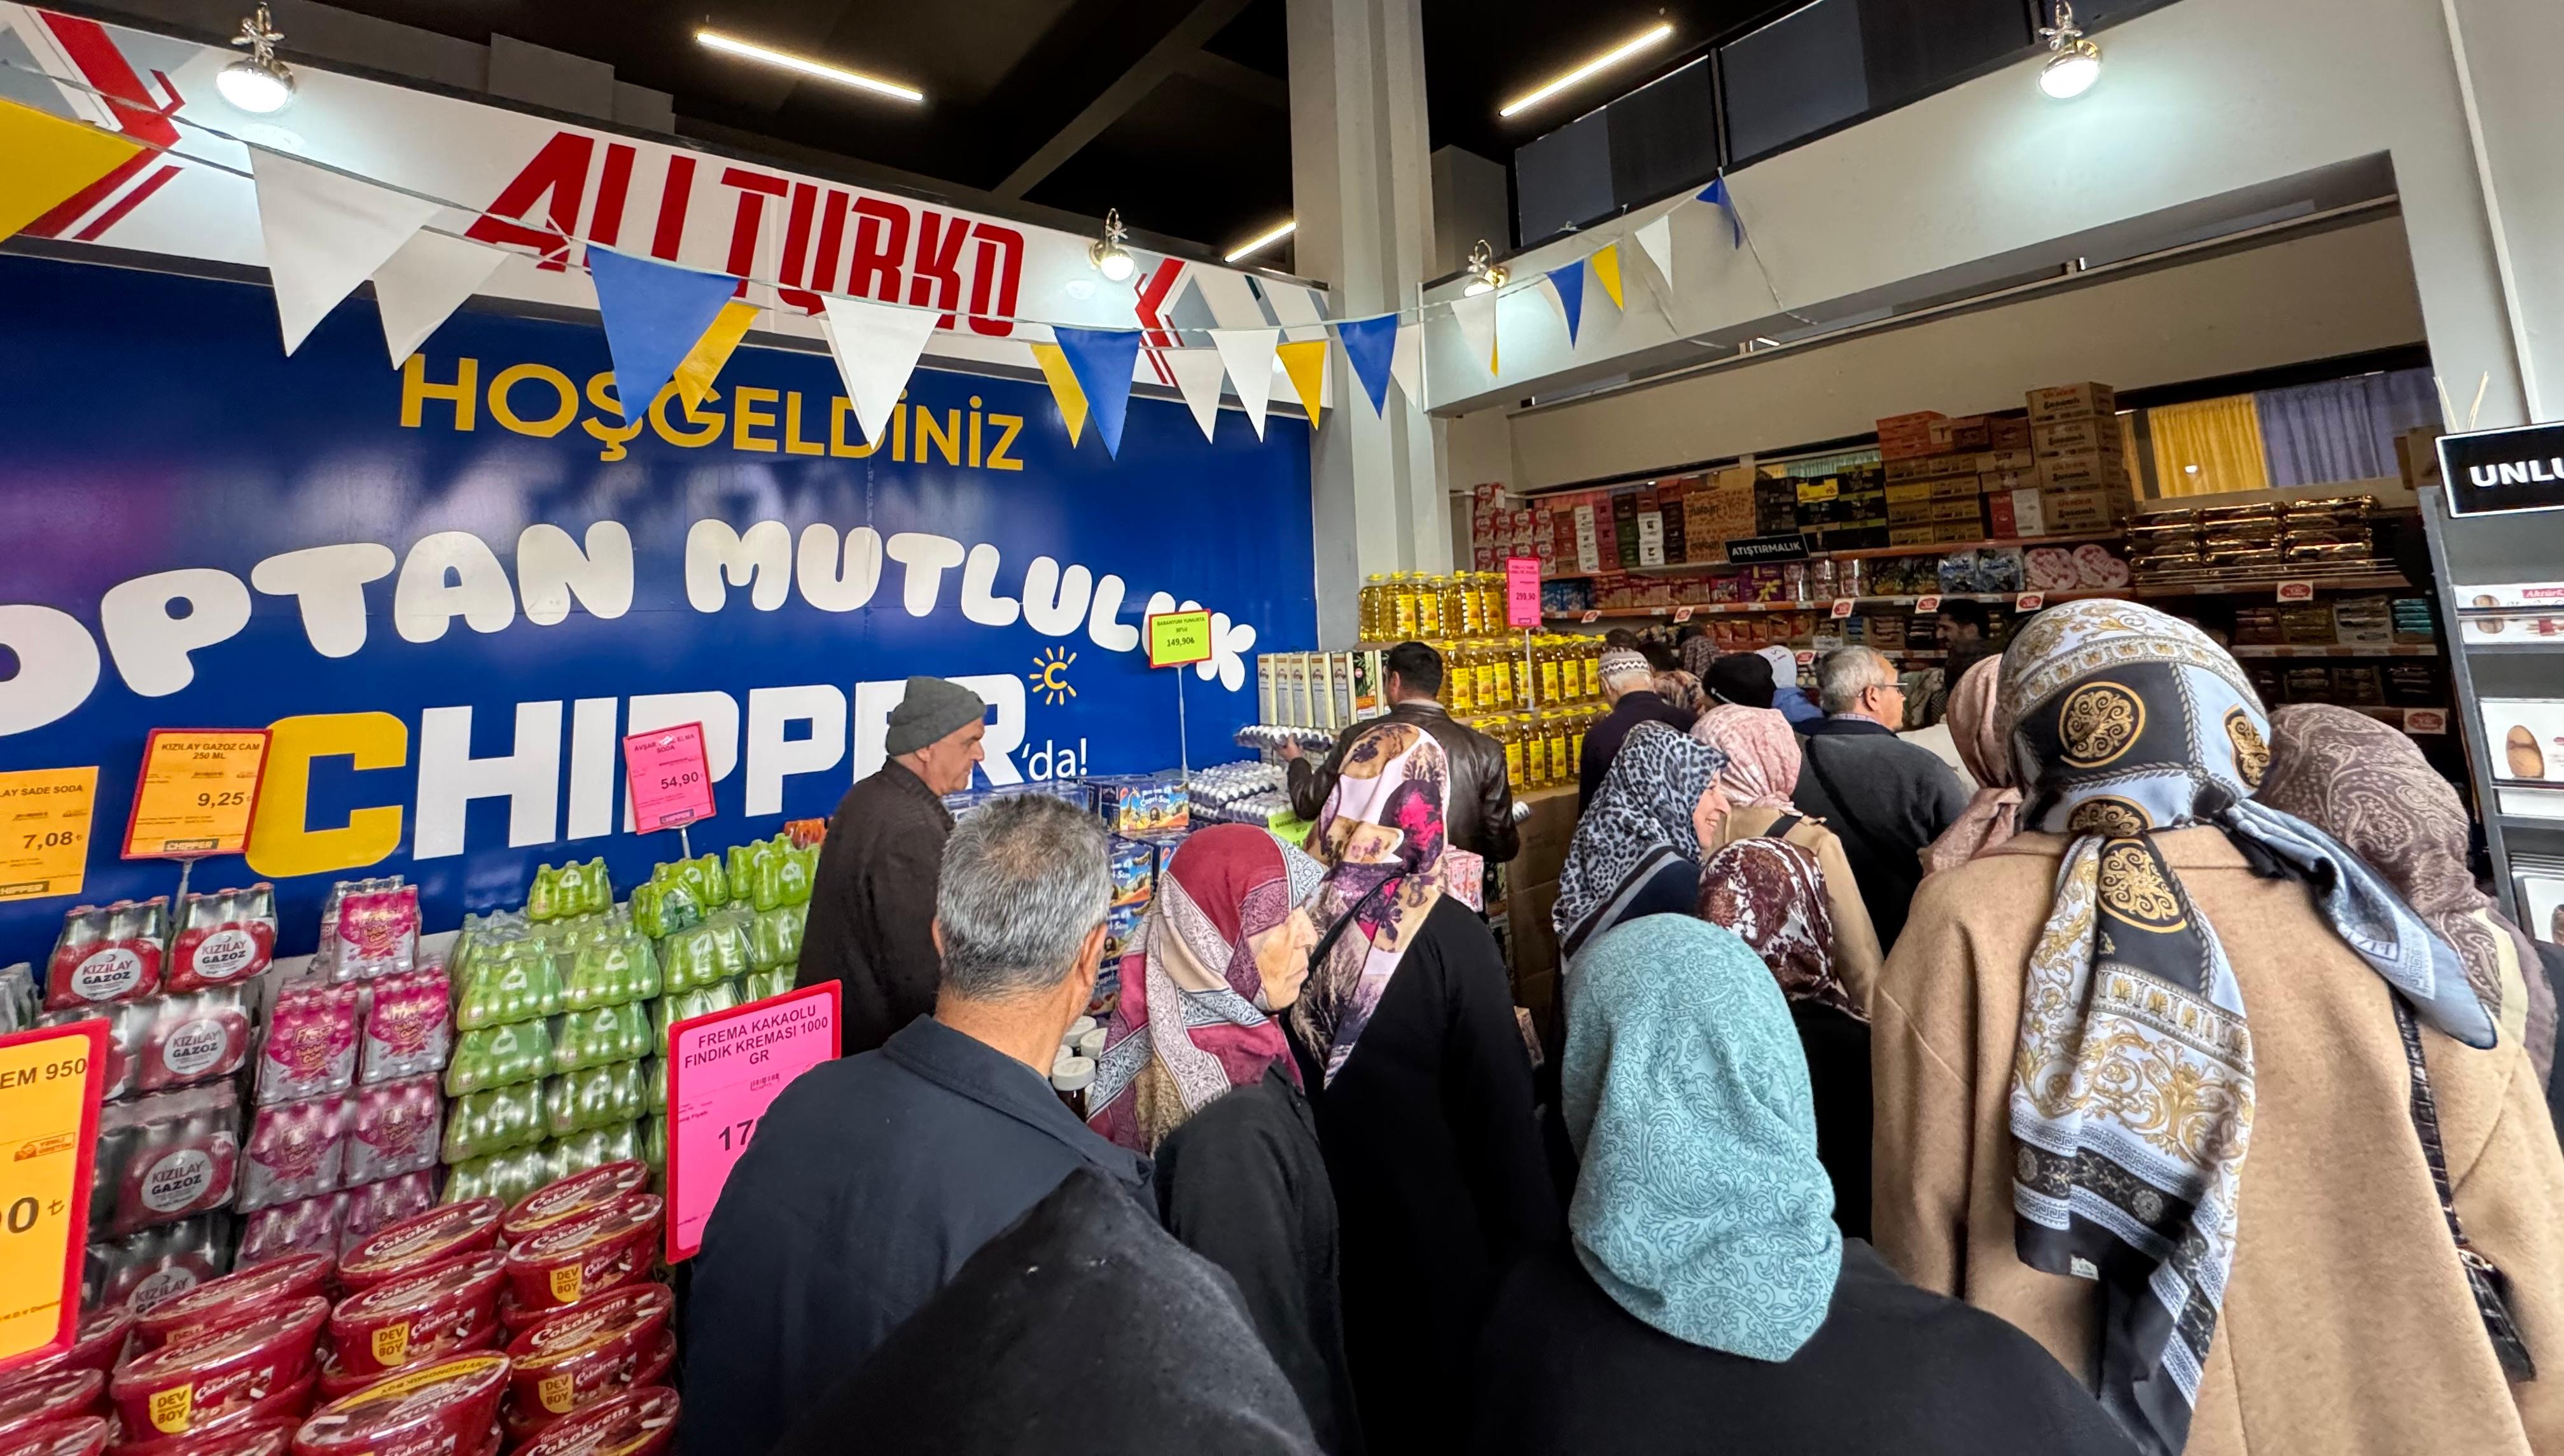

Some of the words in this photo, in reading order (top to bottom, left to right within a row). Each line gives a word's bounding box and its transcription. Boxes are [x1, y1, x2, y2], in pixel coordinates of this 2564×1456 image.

[1732, 541, 1802, 558] ATIŞTIRMALIK
[162, 743, 200, 751] KIZILAY
[203, 743, 237, 751] GAZOZ
[193, 752, 210, 760] 250
[660, 772, 699, 790] 54,90
[20, 786, 50, 796] SADE
[23, 831, 73, 851] 7,08
[202, 939, 247, 955] KIZILAY
[202, 950, 246, 964] GAZOZ
[83, 959, 134, 975] KIZILAY
[83, 971, 131, 985] GAZOZ
[698, 1025, 747, 1048] FREMA
[751, 1005, 816, 1034] KAKAOLU
[173, 1030, 221, 1048] KIZILAY
[685, 1045, 732, 1068] FINDIK
[735, 1029, 797, 1055] KREMASI
[800, 1016, 828, 1035] 1000
[172, 1043, 218, 1058] GAZOZ
[749, 1050, 769, 1065] GR
[46, 1058, 87, 1081] 950
[152, 1160, 205, 1184] KIZILAY
[151, 1174, 202, 1195] GAZOZ
[556, 1266, 579, 1280] DEV
[136, 1277, 189, 1302] KIZILAY
[556, 1282, 578, 1294] BOY
[379, 1326, 405, 1342] DEV
[379, 1342, 403, 1357] BOY
[545, 1377, 569, 1391] DEV
[157, 1390, 188, 1409] DEV
[546, 1392, 569, 1405] BOY
[157, 1406, 187, 1424] BOY
